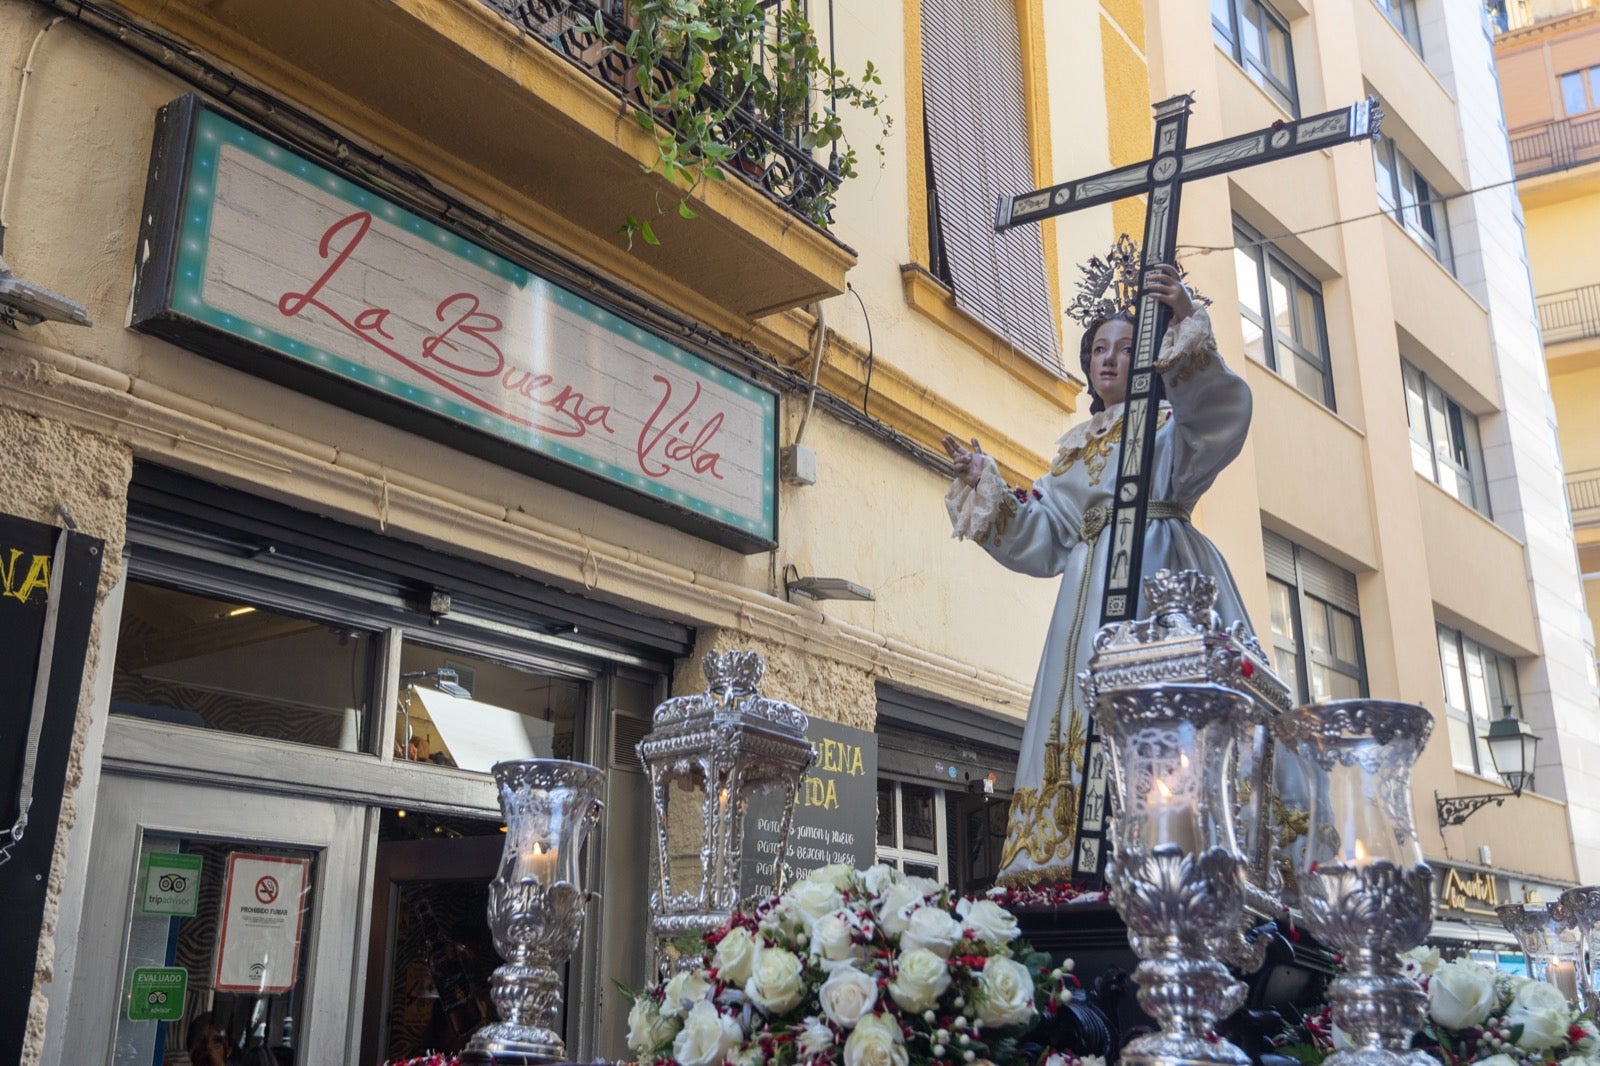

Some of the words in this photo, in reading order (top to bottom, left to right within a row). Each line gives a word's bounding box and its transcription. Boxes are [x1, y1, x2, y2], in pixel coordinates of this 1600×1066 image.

[422, 293, 614, 434] Buena
[638, 375, 725, 479] Vida
[803, 736, 866, 777] UENA
[240, 906, 269, 914] PROHIBIDO
[270, 908, 288, 916] FUMAR
[137, 974, 182, 983] EVALUADO
